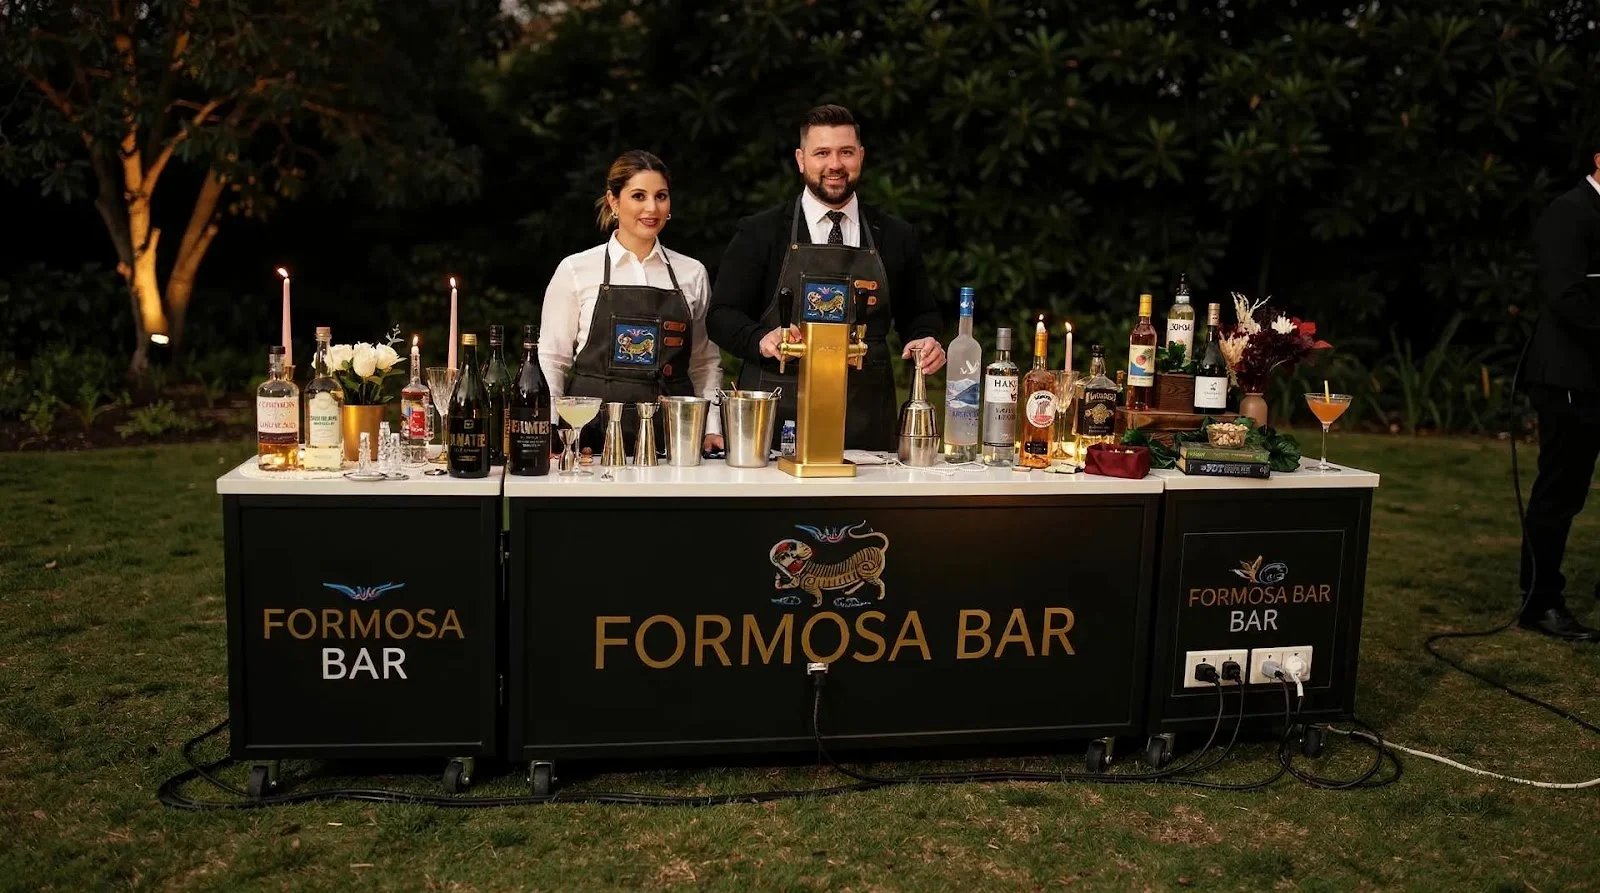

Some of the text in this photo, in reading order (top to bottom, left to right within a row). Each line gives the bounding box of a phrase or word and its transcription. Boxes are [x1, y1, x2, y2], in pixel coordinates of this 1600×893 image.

[1189, 584, 1331, 608] FORMOSA BAR
[263, 608, 465, 640] FORMOSA
[1229, 608, 1279, 633] BAR
[595, 607, 1077, 670] FORMOSA BAR
[322, 647, 408, 680] BAR
